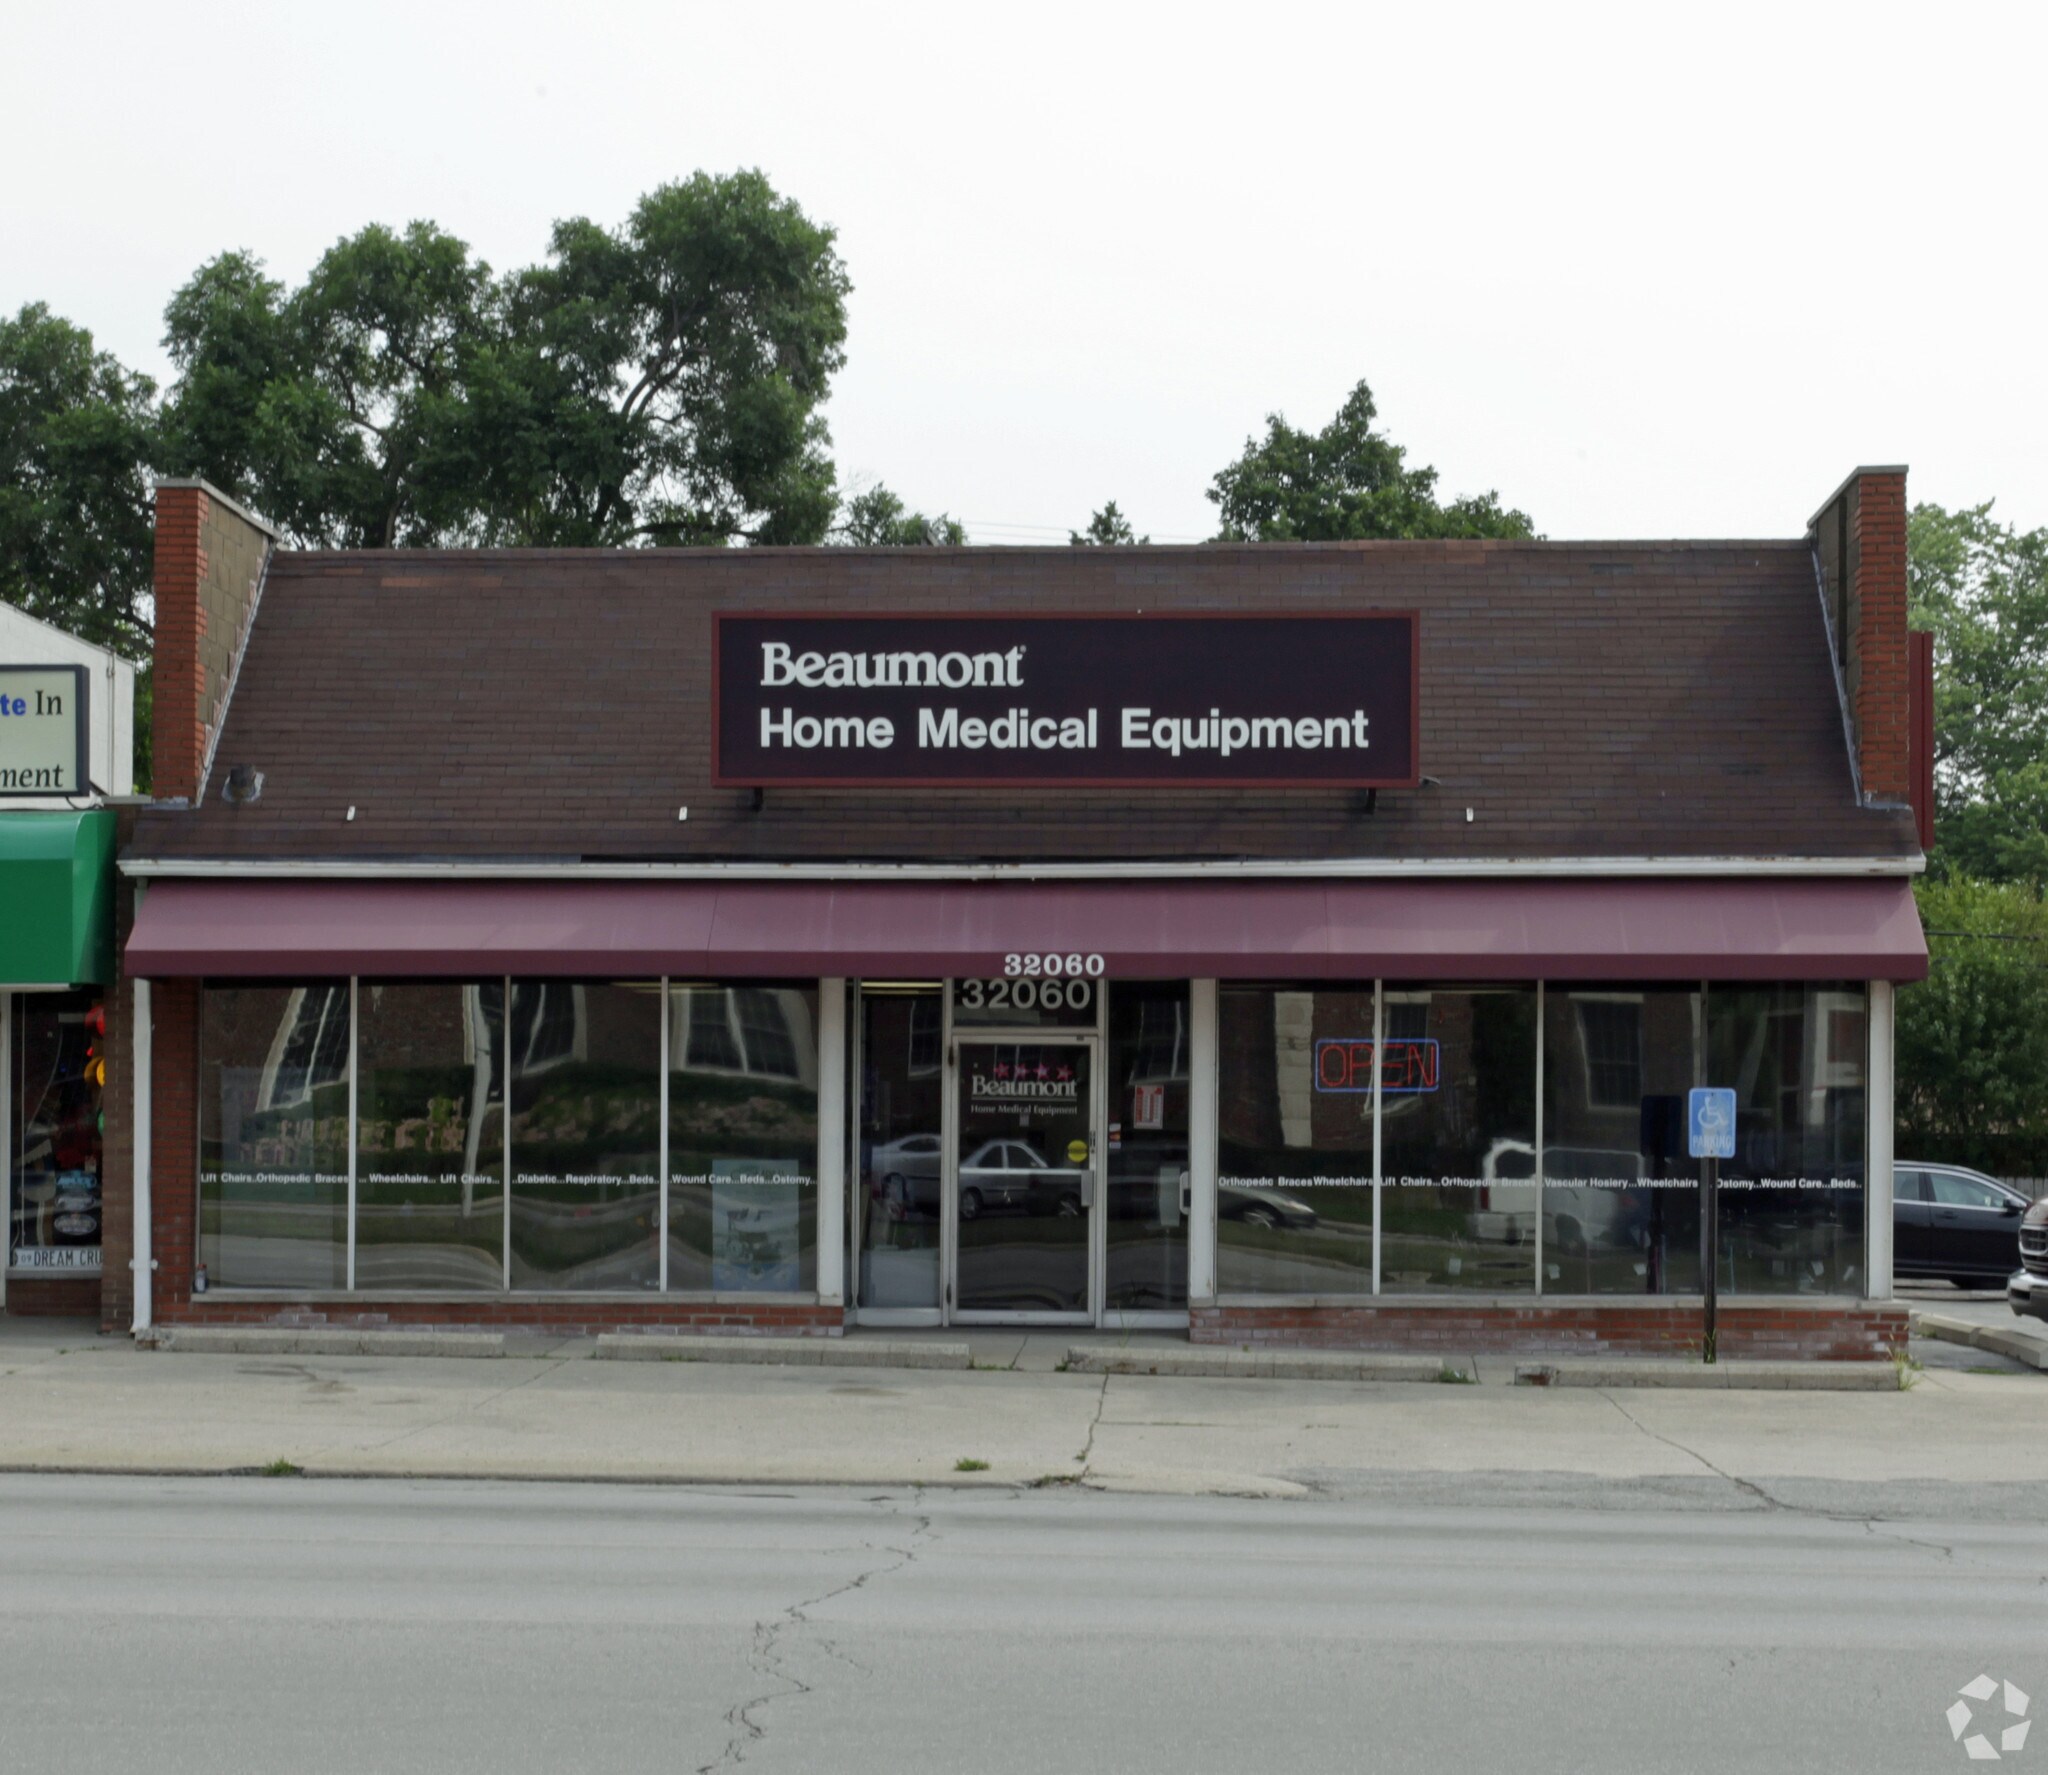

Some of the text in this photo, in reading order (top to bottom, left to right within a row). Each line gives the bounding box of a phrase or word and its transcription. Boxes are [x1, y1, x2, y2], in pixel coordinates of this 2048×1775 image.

[760, 642, 1024, 687] Beaumont
[35, 690, 62, 715] In
[761, 707, 1369, 756] Home Medical Equipment
[1004, 953, 1104, 976] 32060
[962, 978, 1090, 1010] 32060
[1320, 1044, 1434, 1087] OPEN
[972, 1074, 1077, 1096] Beaumont
[971, 1104, 1077, 1116] Home Medical Equipment
[1692, 1135, 1731, 1149] PARKING
[200, 1172, 217, 1183] Lift
[440, 1173, 456, 1183] Lift
[1219, 1176, 1273, 1187] Orthopedic
[1379, 1176, 1396, 1187] Lift
[34, 1250, 74, 1266] DREAM
